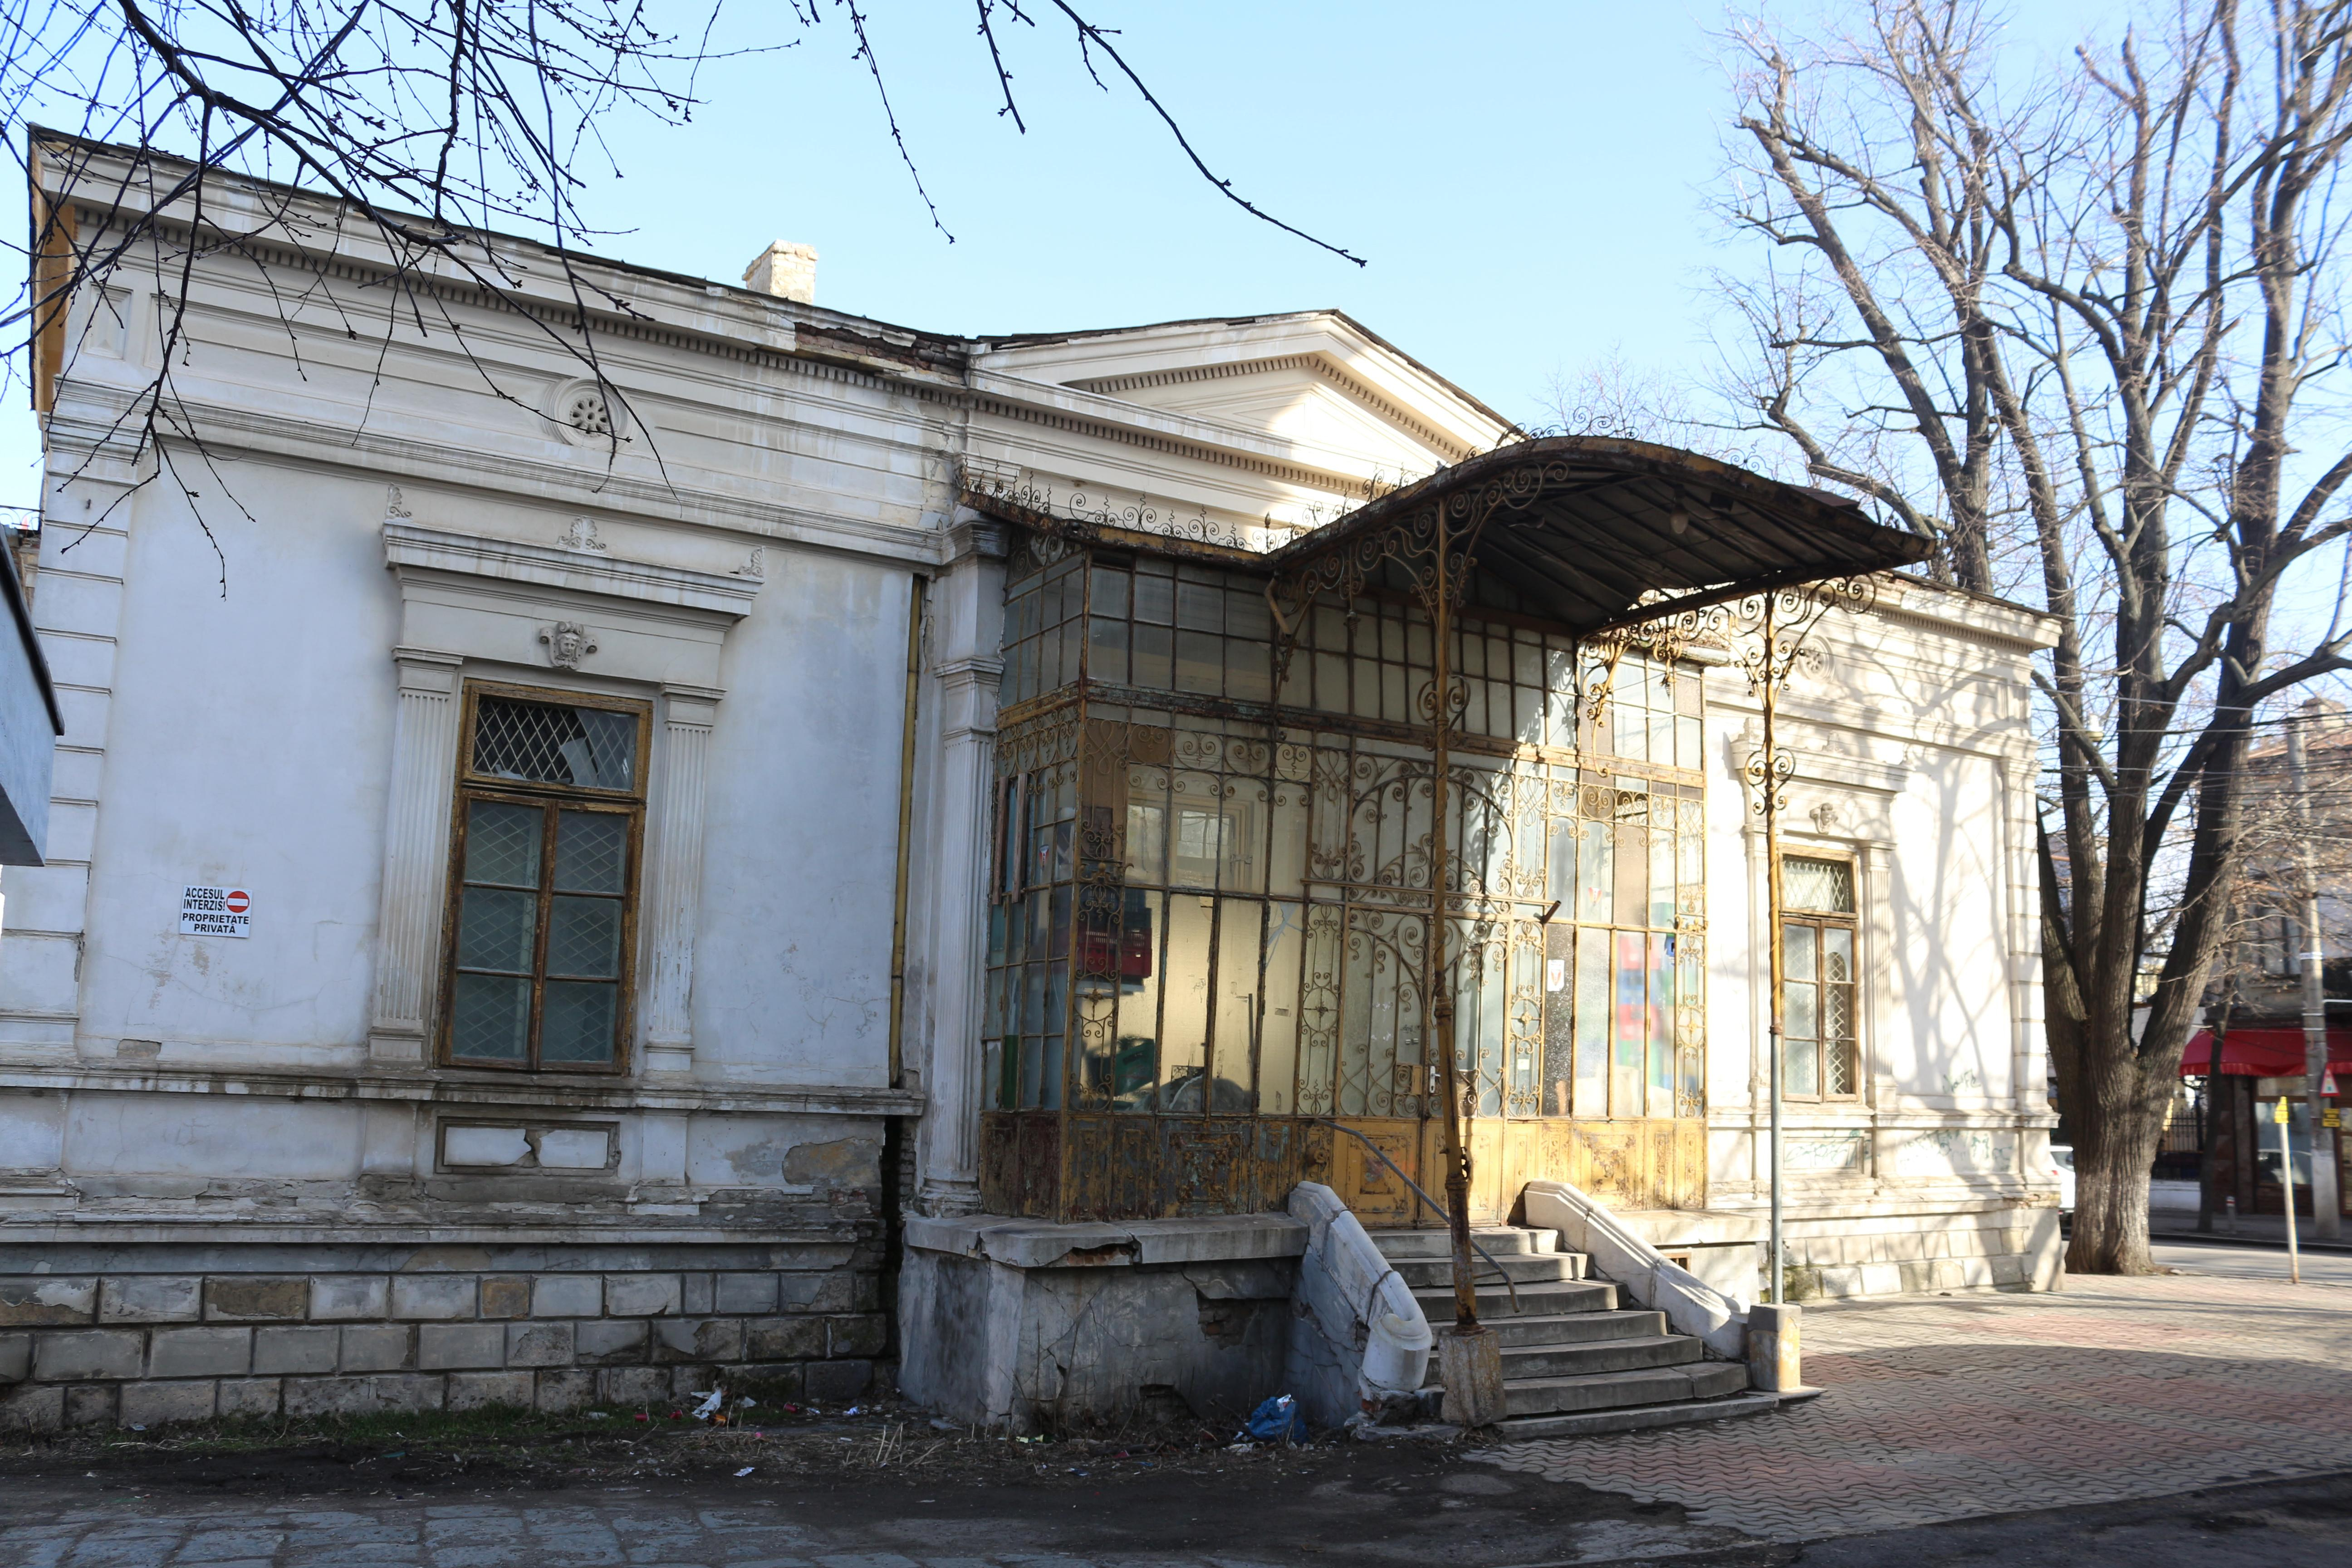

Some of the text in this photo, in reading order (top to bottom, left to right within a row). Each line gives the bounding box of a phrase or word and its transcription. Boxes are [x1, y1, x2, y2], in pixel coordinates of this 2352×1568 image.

[185, 888, 225, 900] ACCESUL
[183, 899, 225, 911] INTERZIS!
[182, 913, 249, 925] PROPRIETATE
[194, 923, 235, 933] PRIVATĂ
